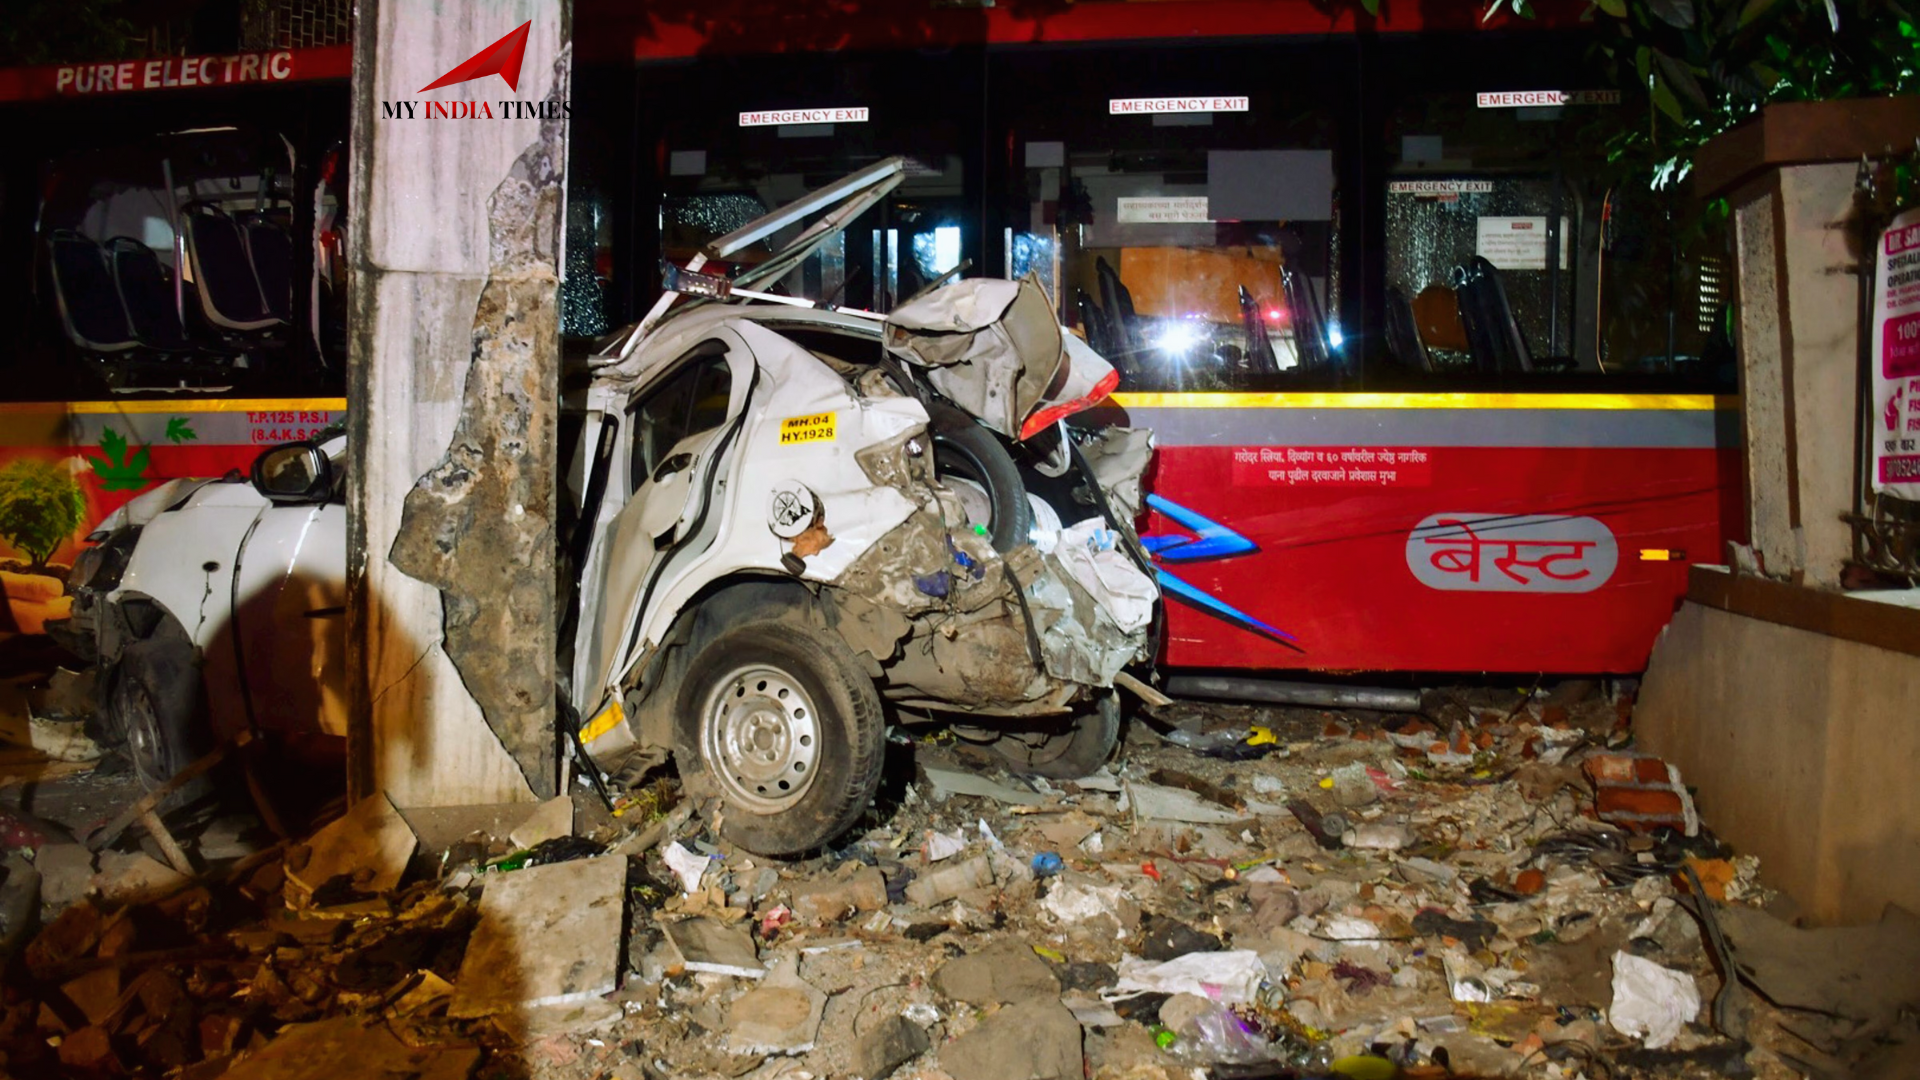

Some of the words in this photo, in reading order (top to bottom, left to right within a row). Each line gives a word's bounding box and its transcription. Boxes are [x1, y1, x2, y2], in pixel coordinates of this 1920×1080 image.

[57, 63, 135, 93] PURE
[143, 52, 292, 89] ELECTRIC
[1111, 99, 1208, 112] EMERGENCY
[1213, 98, 1247, 109] EXIT
[1478, 91, 1579, 106] EMERGENCY
[1584, 91, 1620, 104] EXIT
[741, 110, 831, 125] EMERGENCY
[835, 109, 867, 120] EXIT
[1391, 182, 1462, 192] EMERGENCY
[1466, 181, 1492, 191] EXIT
[246, 411, 295, 423] T.P.125
[299, 411, 329, 424] P.S.I
[787, 415, 830, 428] MH.04
[781, 427, 834, 443] HY.1928
[1316, 452, 1324, 463] व
[1424, 519, 1597, 585] बेस्ट
